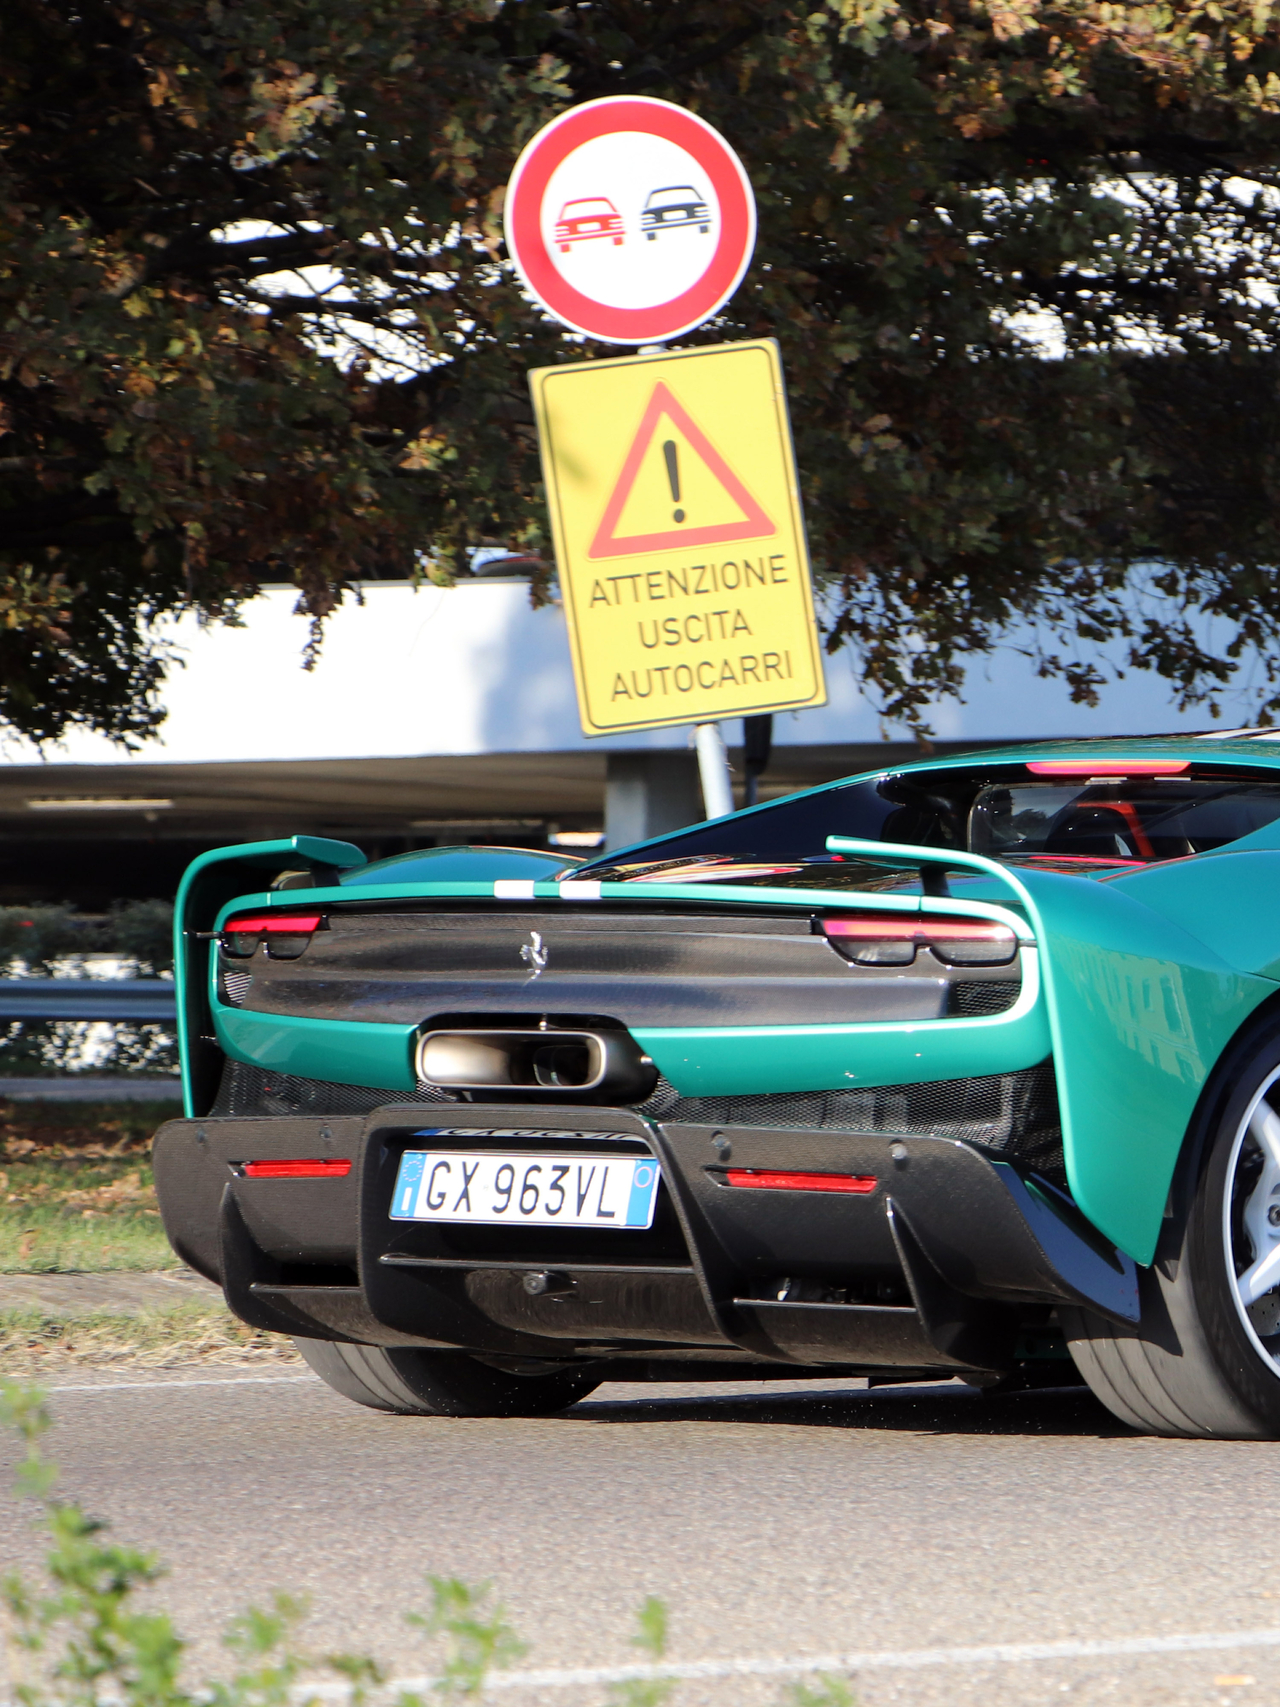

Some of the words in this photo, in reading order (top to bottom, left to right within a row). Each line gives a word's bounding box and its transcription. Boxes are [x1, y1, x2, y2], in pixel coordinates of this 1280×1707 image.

[589, 554, 788, 608] ATTENZIONE
[638, 608, 753, 649] USCITA
[611, 650, 793, 702] AUTOCARRI
[426, 1160, 480, 1213] GX
